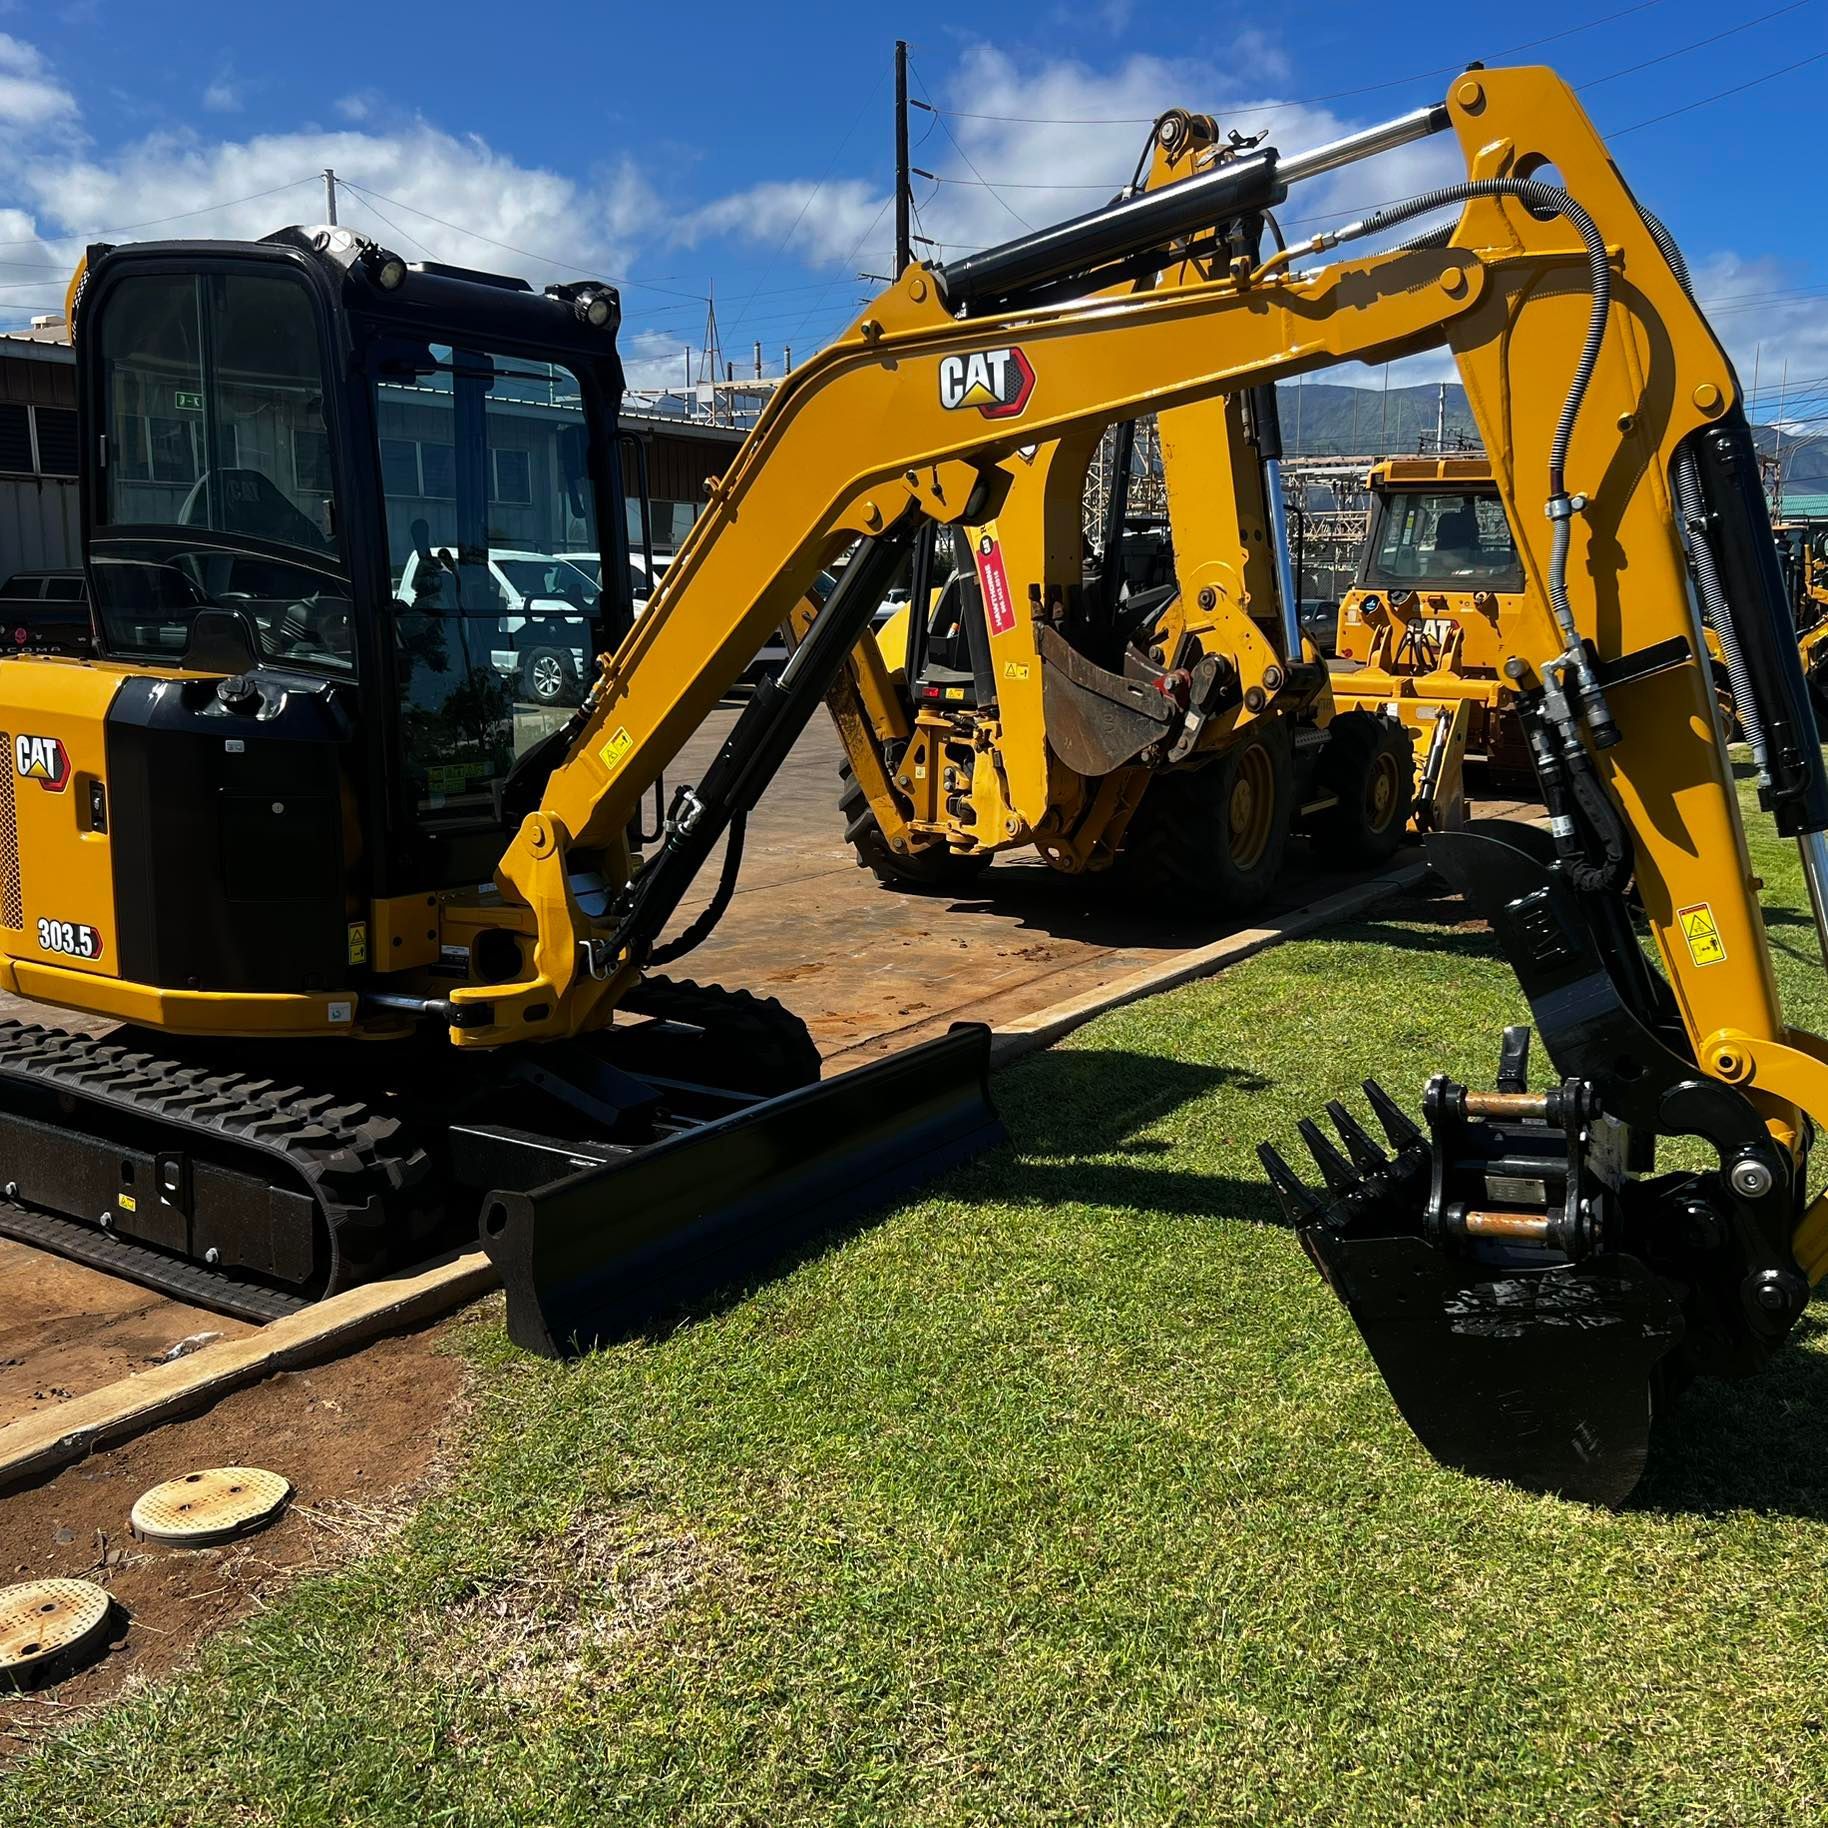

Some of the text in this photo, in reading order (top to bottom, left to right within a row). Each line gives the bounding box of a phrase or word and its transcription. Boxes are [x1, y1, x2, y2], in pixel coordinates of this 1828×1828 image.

[940, 349, 1010, 409] CAT
[982, 538, 991, 554] CAT
[984, 563, 1002, 627] HAWTHORNE
[15, 735, 57, 780] CAT
[38, 918, 93, 957] 303.5
